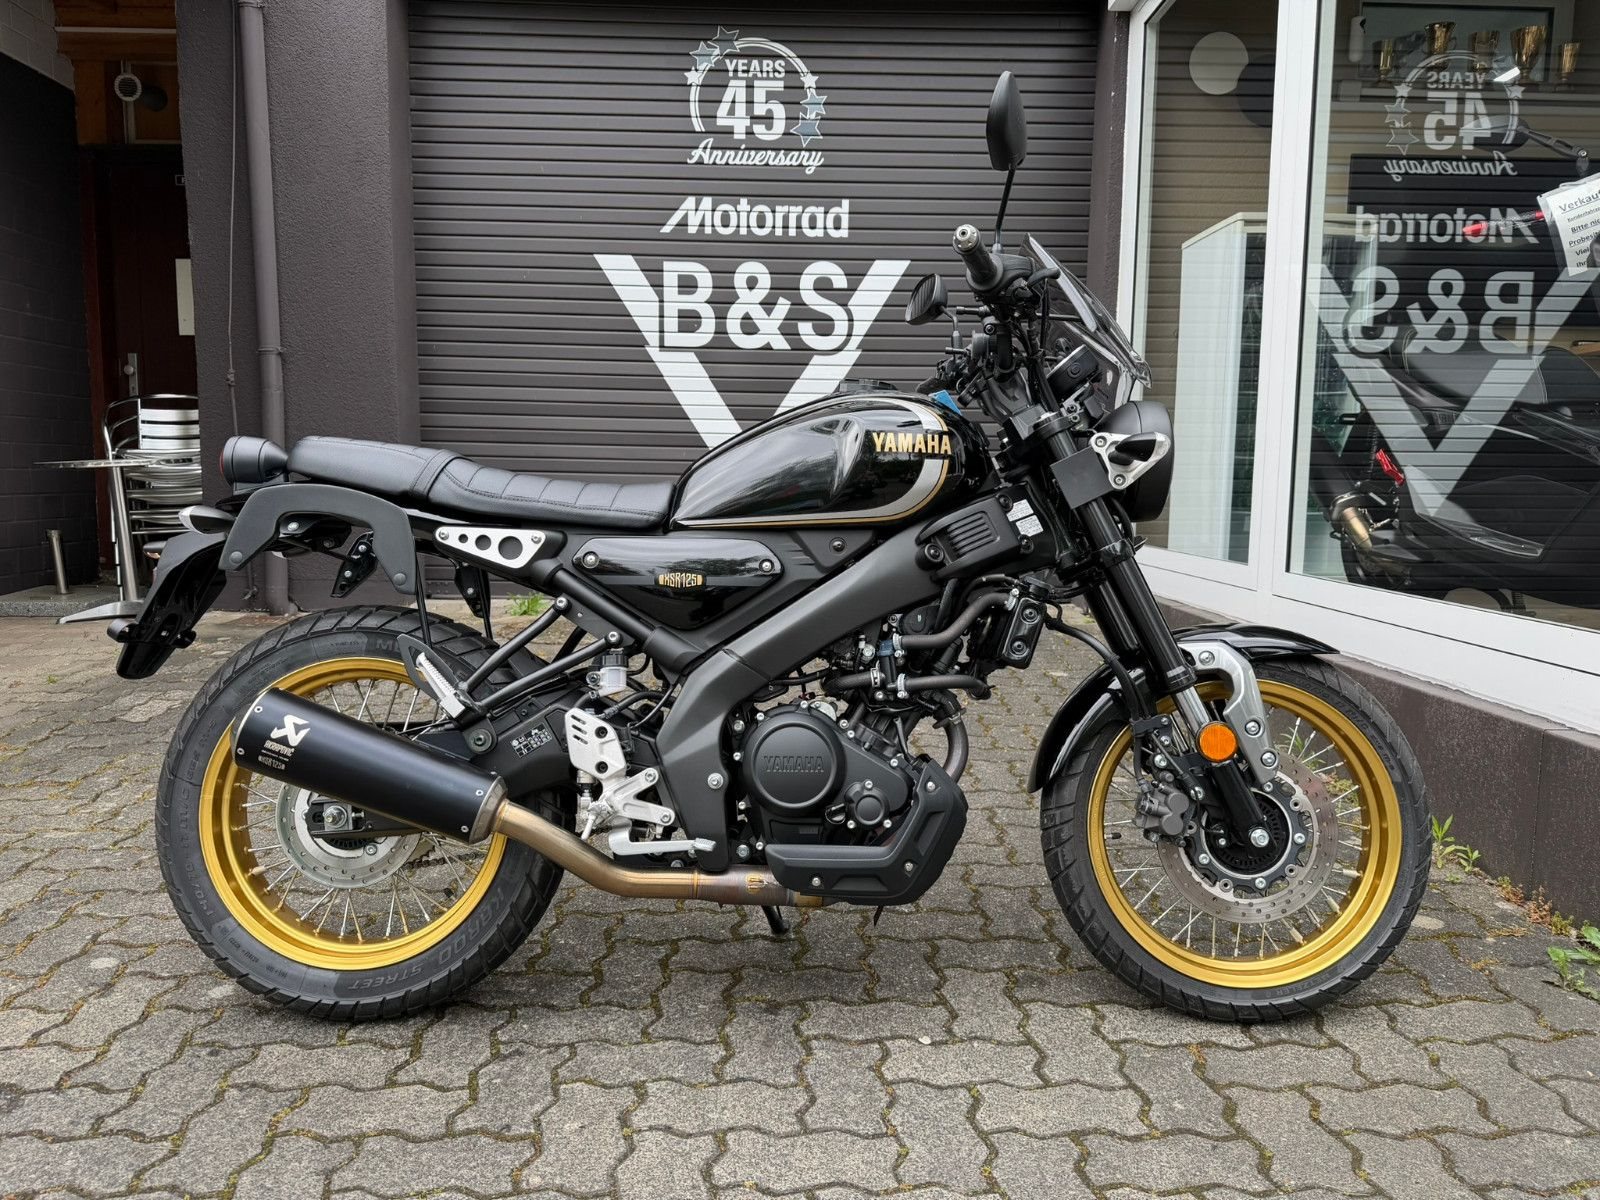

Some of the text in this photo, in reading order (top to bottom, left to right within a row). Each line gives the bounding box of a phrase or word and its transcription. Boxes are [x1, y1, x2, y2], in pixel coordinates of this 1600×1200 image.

[725, 59, 786, 78] YEARS
[716, 79, 786, 141] 45
[687, 138, 824, 174] Anniversary
[1558, 190, 1600, 212] Verkau
[659, 196, 850, 238] Motorrad
[662, 261, 849, 351] B&S
[872, 432, 952, 455] YAMAHA
[663, 572, 697, 588] XSR125
[763, 755, 825, 773] YAMAHA
[348, 963, 424, 990] STREET
